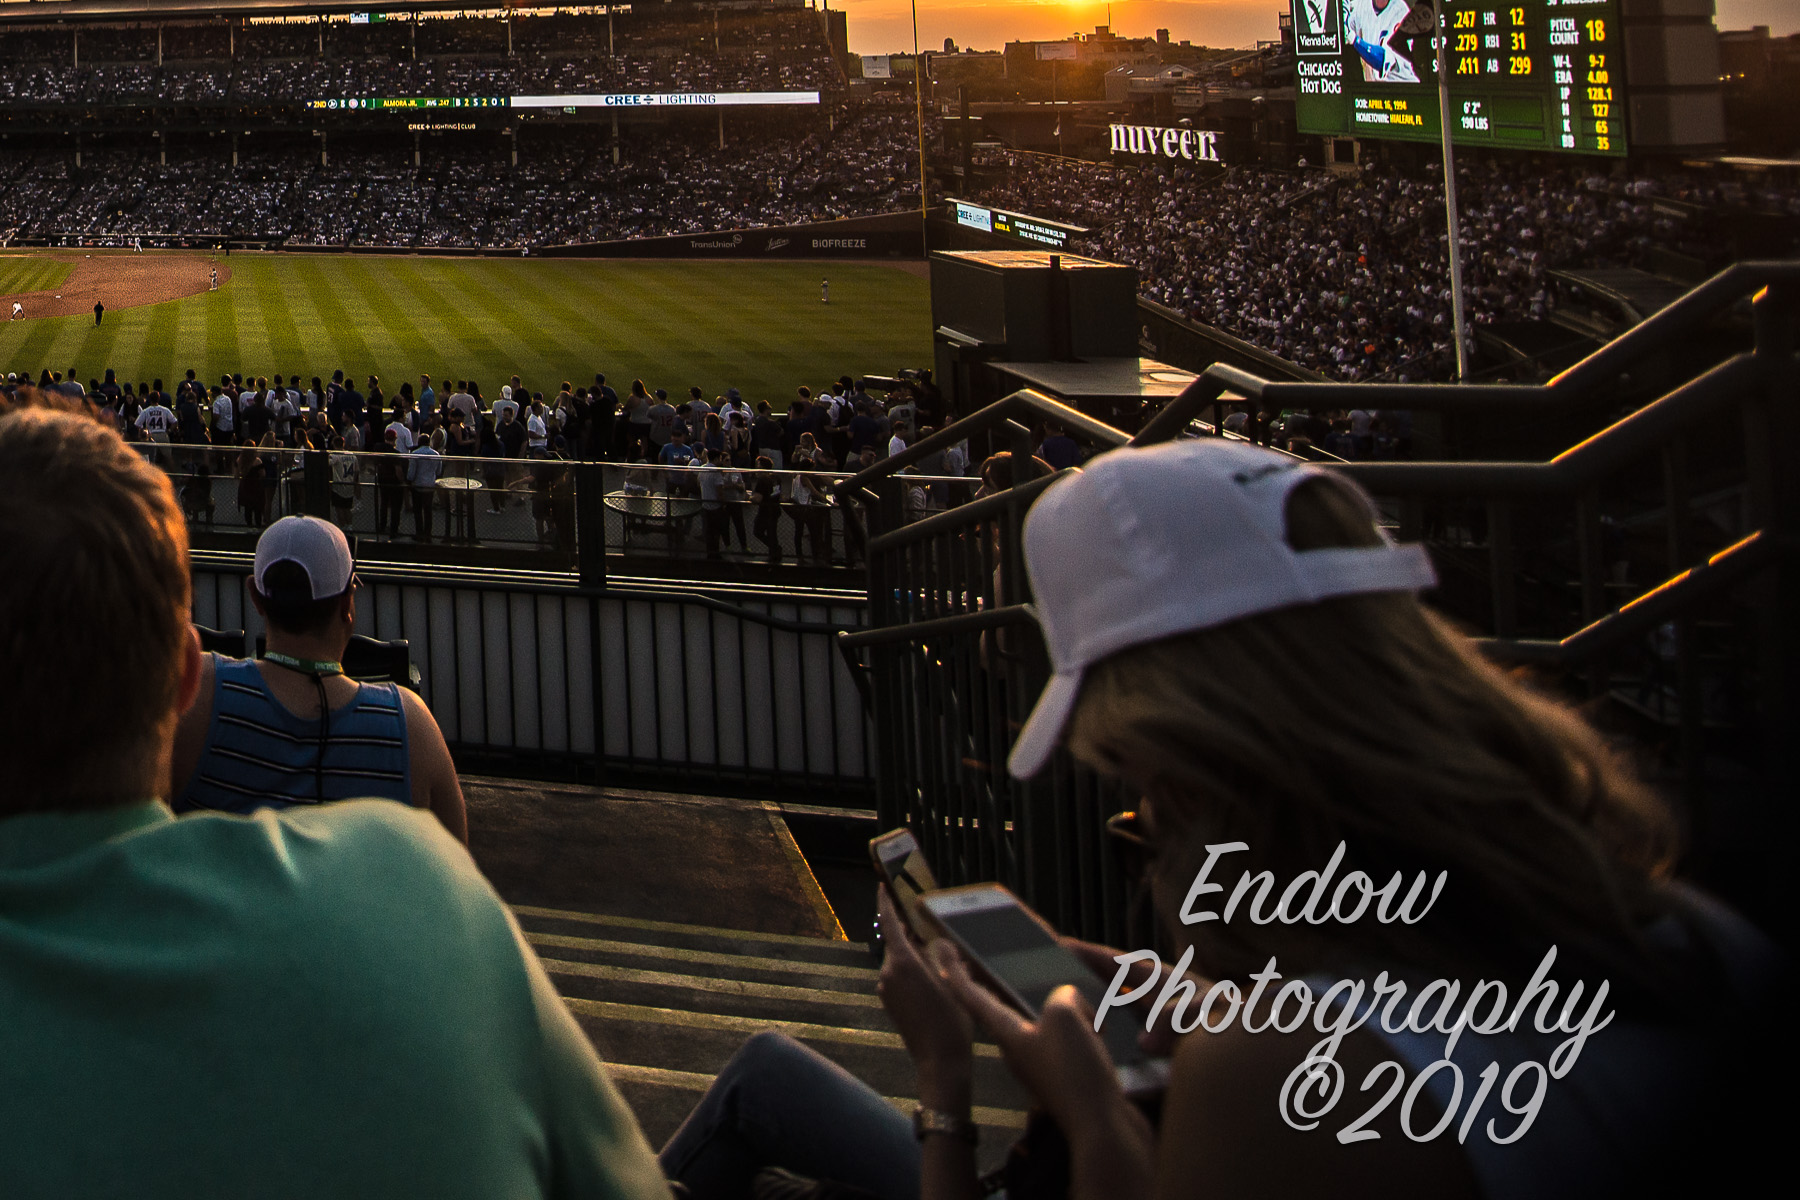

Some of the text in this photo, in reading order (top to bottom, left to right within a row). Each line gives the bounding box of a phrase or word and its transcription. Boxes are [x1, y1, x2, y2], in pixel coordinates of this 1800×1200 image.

[1453, 10, 1476, 28] .247
[1483, 11, 1497, 26] HR
[1509, 7, 1525, 26] 12
[1549, 18, 1576, 32] PITCH
[1585, 19, 1606, 42] 18
[1299, 34, 1336, 49] Vienna Beef
[1455, 33, 1478, 52] .279
[1484, 34, 1500, 49] RBI
[1511, 31, 1527, 51] 31
[1549, 31, 1580, 45] COUNT
[1298, 60, 1342, 76] CHICAGO'S
[1457, 56, 1480, 75] .411
[1486, 58, 1500, 73] AB
[1509, 56, 1532, 75] 299
[1553, 55, 1572, 69] W-L
[1588, 54, 1605, 68] 9-7
[1554, 70, 1574, 84] ERA
[1587, 70, 1608, 84] 4.00
[1301, 79, 1342, 94] HOT DOG
[1560, 86, 1571, 100] IP
[604, 94, 716, 106] CREE LIGHTING
[1587, 87, 1613, 101] 128.1
[313, 100, 327, 109] 2ND
[383, 99, 407, 107] ALMORA
[455, 98, 461, 107] B
[464, 98, 469, 107] 2
[473, 98, 479, 107] S
[482, 98, 487, 107] 2
[500, 98, 505, 106] 1
[1561, 103, 1570, 117] H
[1592, 103, 1609, 118] 127
[1461, 116, 1489, 131] 190 LBS
[1562, 119, 1571, 132] K
[1595, 120, 1609, 135] 65
[1109, 124, 1219, 161] nuveen
[1597, 136, 1610, 150] 35
[690, 240, 736, 248] TransUnion
[812, 239, 866, 248] BIOFREEZE
[149, 417, 163, 429] 44
